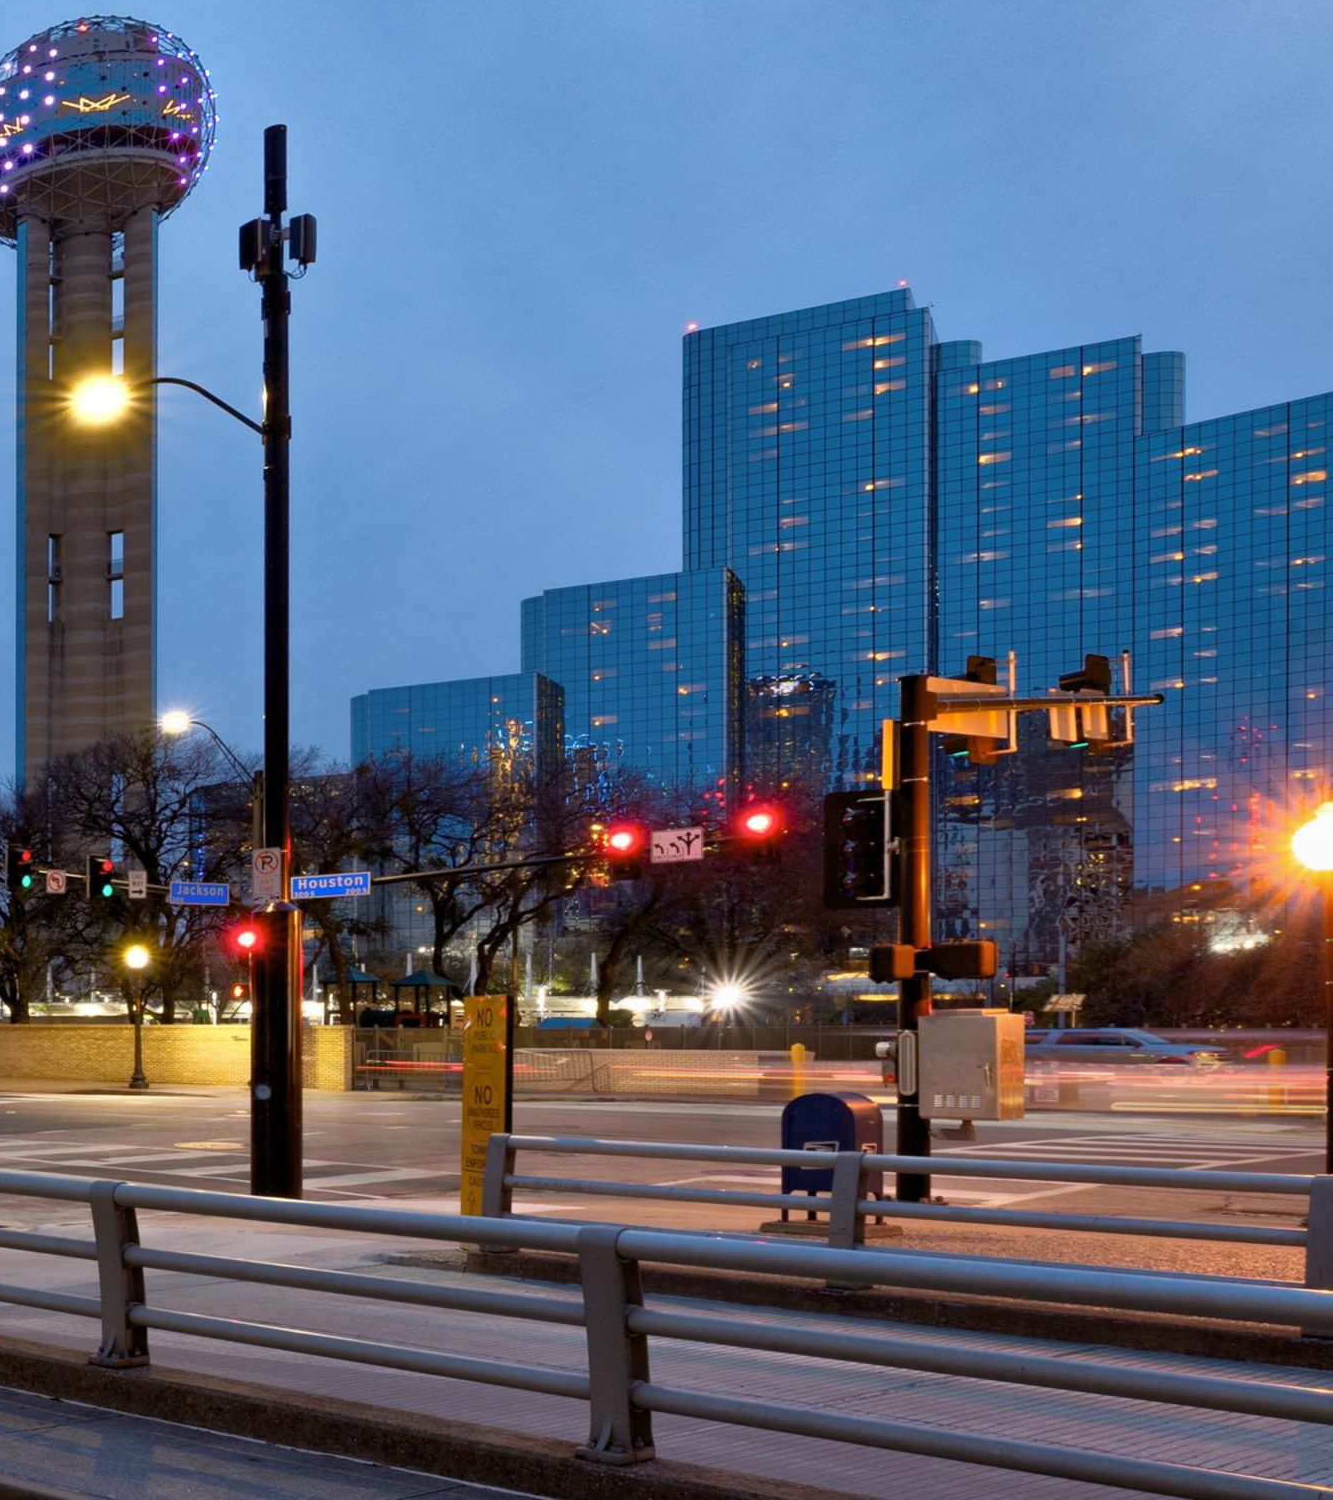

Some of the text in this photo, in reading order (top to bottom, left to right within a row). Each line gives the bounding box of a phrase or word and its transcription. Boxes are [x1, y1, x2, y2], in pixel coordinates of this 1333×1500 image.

[298, 876, 364, 890] Houston
[176, 884, 225, 897] Jackson
[476, 1008, 493, 1028] NO
[474, 1030, 496, 1040] PUBLIC
[471, 1043, 499, 1054] PARKING
[474, 1085, 493, 1106] NO
